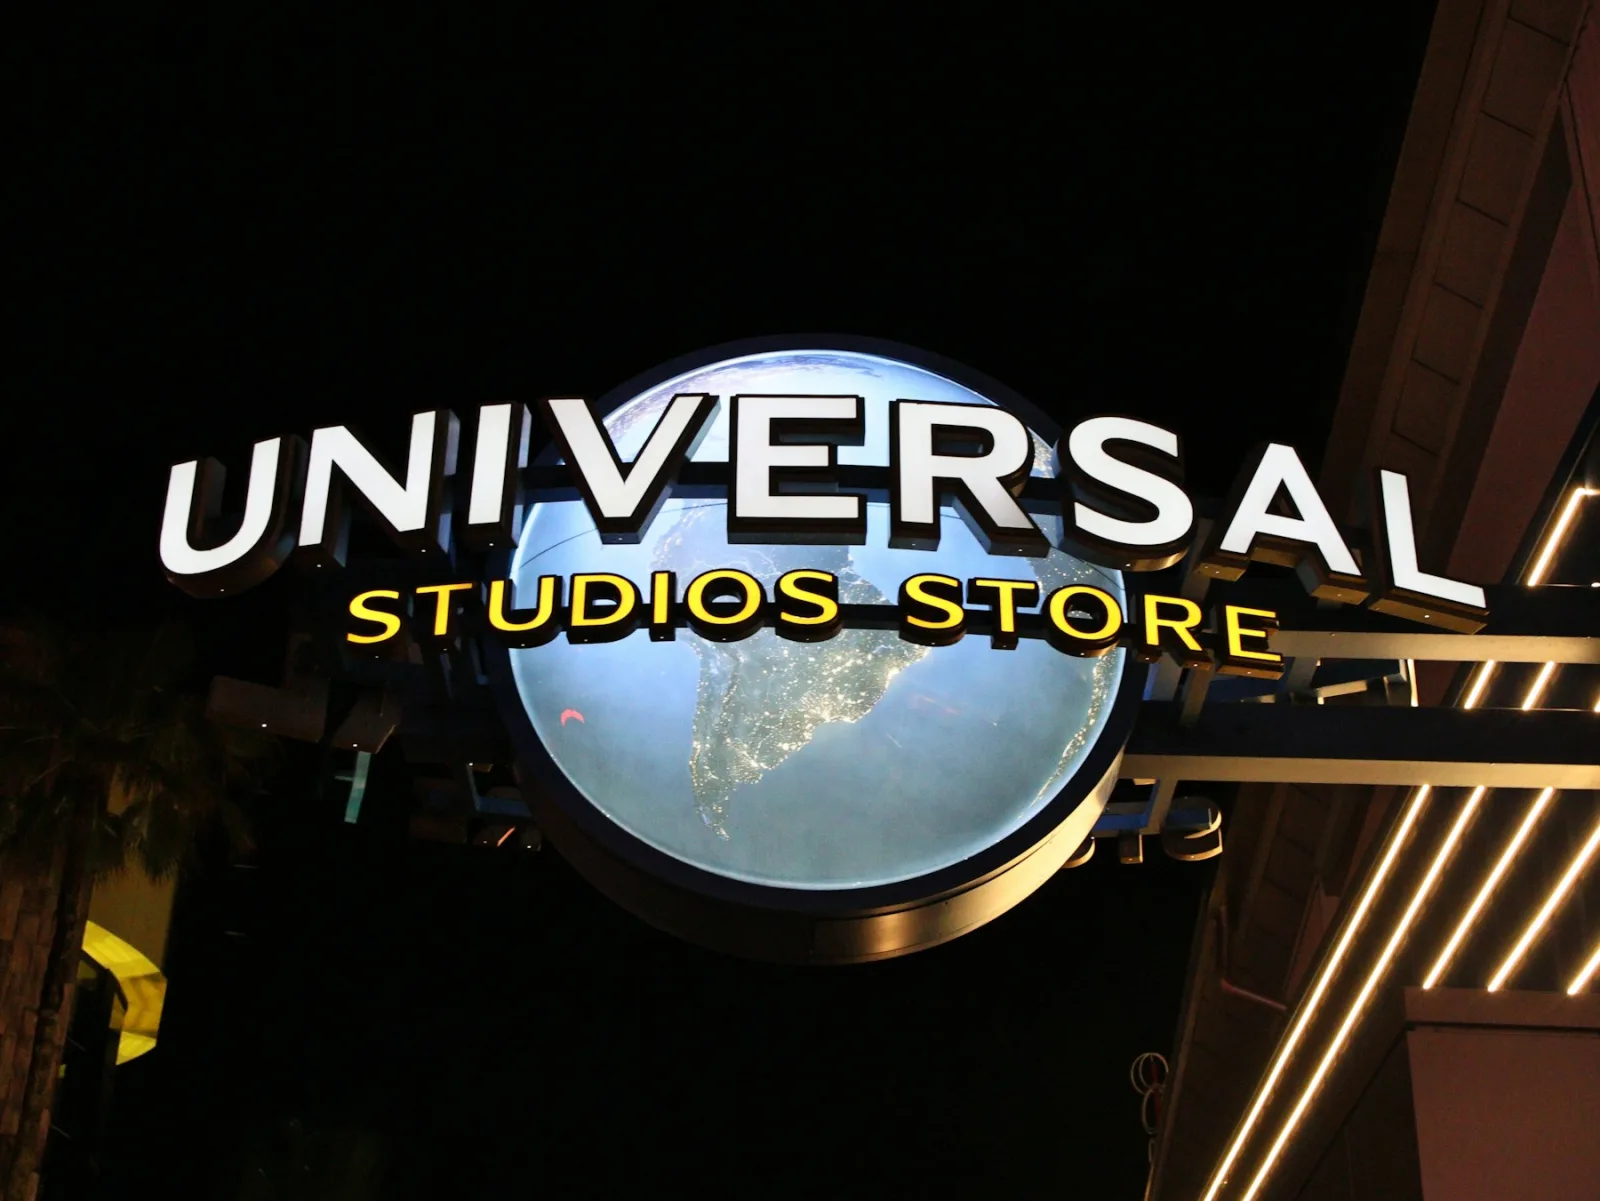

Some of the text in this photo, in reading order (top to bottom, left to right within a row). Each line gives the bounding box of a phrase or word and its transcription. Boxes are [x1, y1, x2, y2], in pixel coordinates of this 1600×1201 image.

[158, 394, 1487, 609] UNIVERSAL
[346, 569, 1283, 665] STUDIOS STORE
